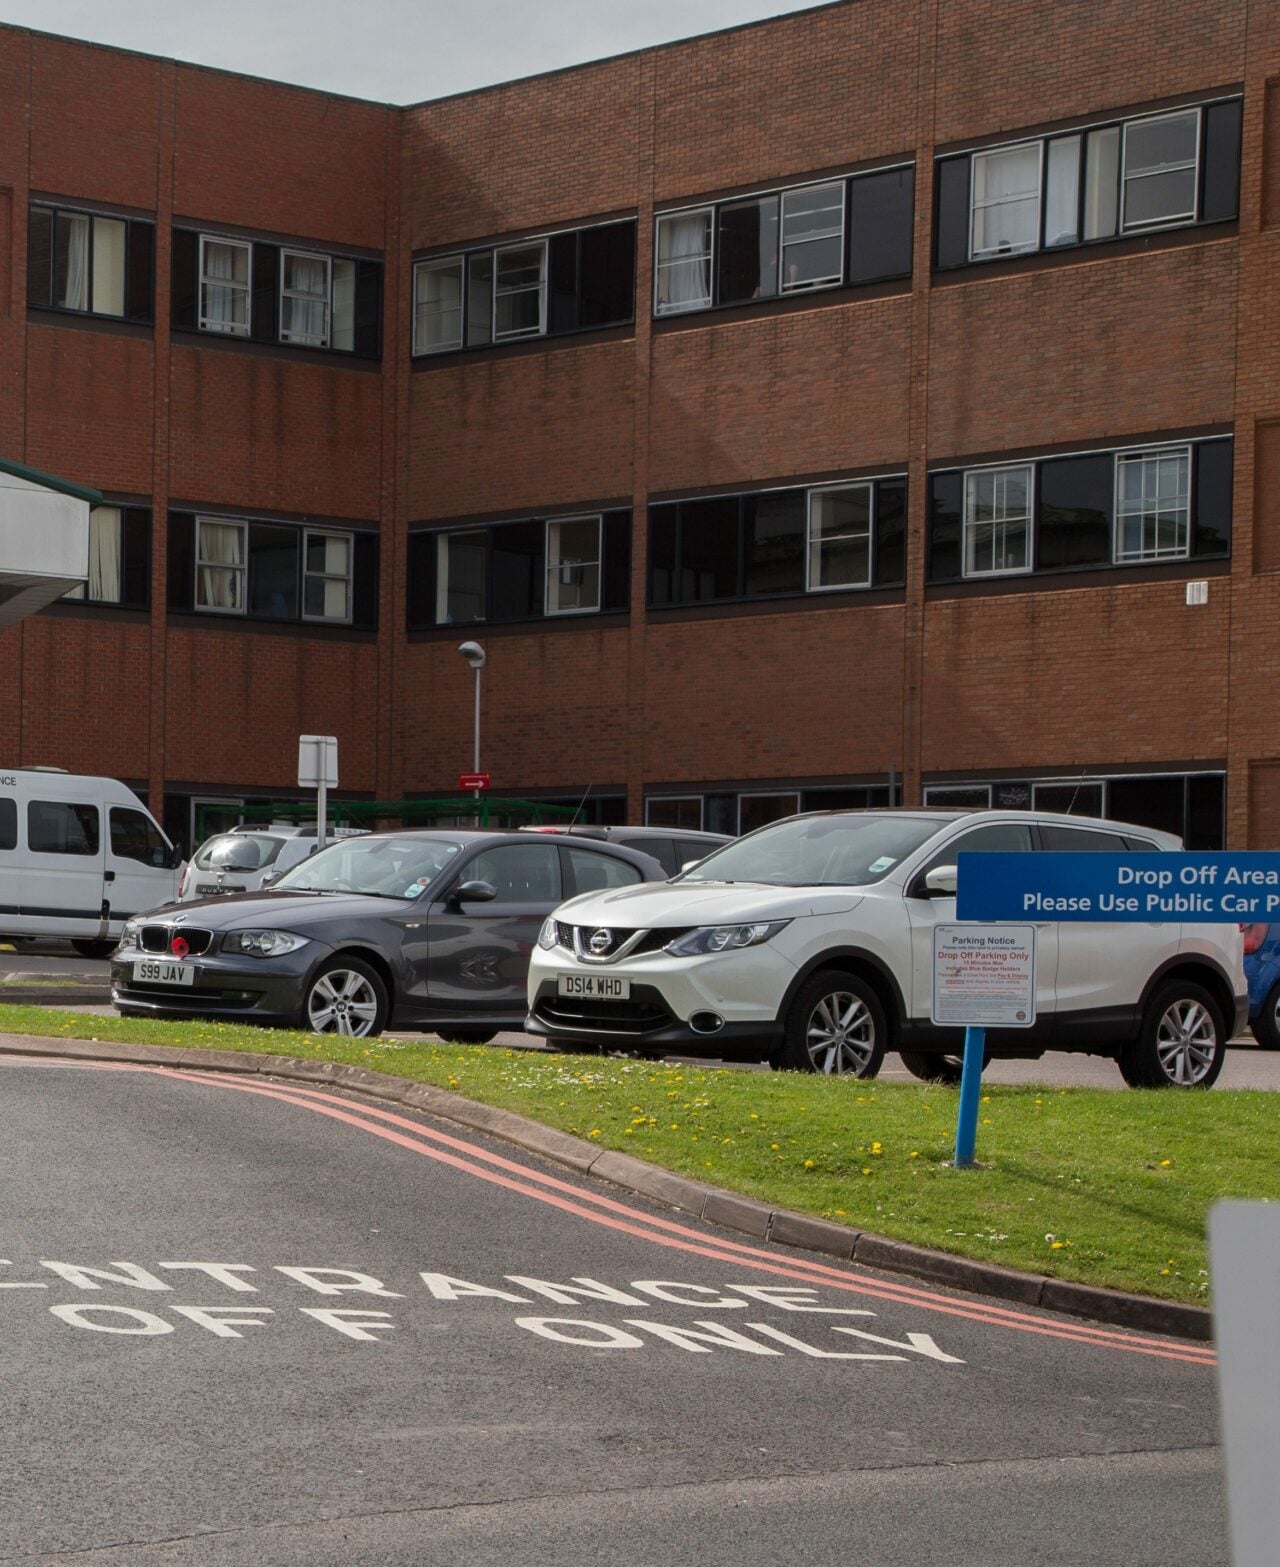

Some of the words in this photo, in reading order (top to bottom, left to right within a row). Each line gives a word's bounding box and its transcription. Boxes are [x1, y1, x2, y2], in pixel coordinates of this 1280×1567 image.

[1117, 866, 1173, 889] Drop
[1179, 865, 1218, 885] Off
[1224, 866, 1280, 885] Area
[1022, 892, 1092, 911] Please
[1098, 893, 1139, 912] Use
[1146, 892, 1214, 912] Public
[1220, 893, 1259, 912] Car
[952, 936, 985, 946] Parking
[987, 936, 1016, 945] Notice
[937, 951, 959, 960] Drop
[960, 951, 974, 959] Off
[975, 951, 1007, 961] Parking
[1009, 952, 1029, 962] Only
[140, 964, 160, 979] S99
[162, 966, 185, 981] JAV
[566, 977, 593, 993] DS14
[597, 978, 622, 995] WHD
[48, 1303, 396, 1341] OFF
[514, 1316, 968, 1364] ONLY
